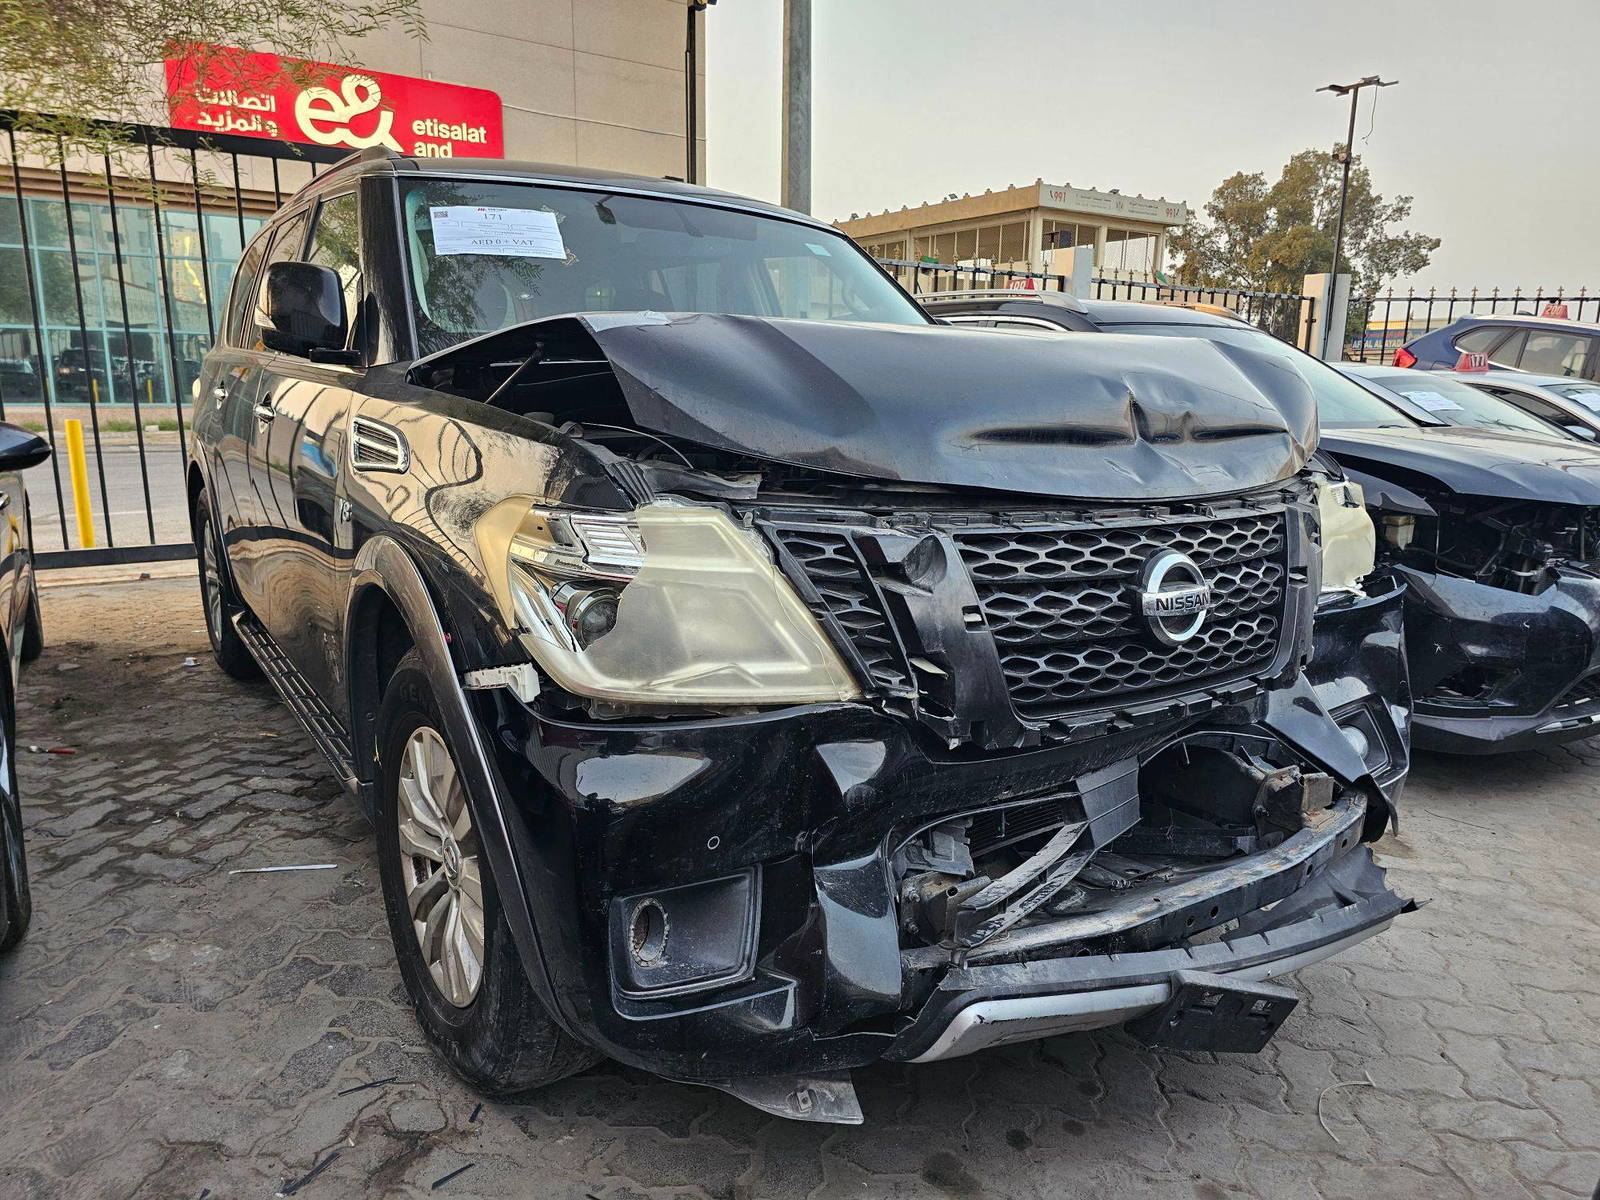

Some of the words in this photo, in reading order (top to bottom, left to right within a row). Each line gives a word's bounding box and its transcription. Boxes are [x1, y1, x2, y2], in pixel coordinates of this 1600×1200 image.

[194, 87, 276, 112] اتصالات
[412, 118, 487, 144] etisalat
[414, 141, 453, 158] and
[484, 213, 502, 221] 171
[472, 238, 493, 246] AED
[512, 238, 535, 247] VAT
[1470, 354, 1485, 368] 177
[1156, 592, 1209, 611] NISSAN
